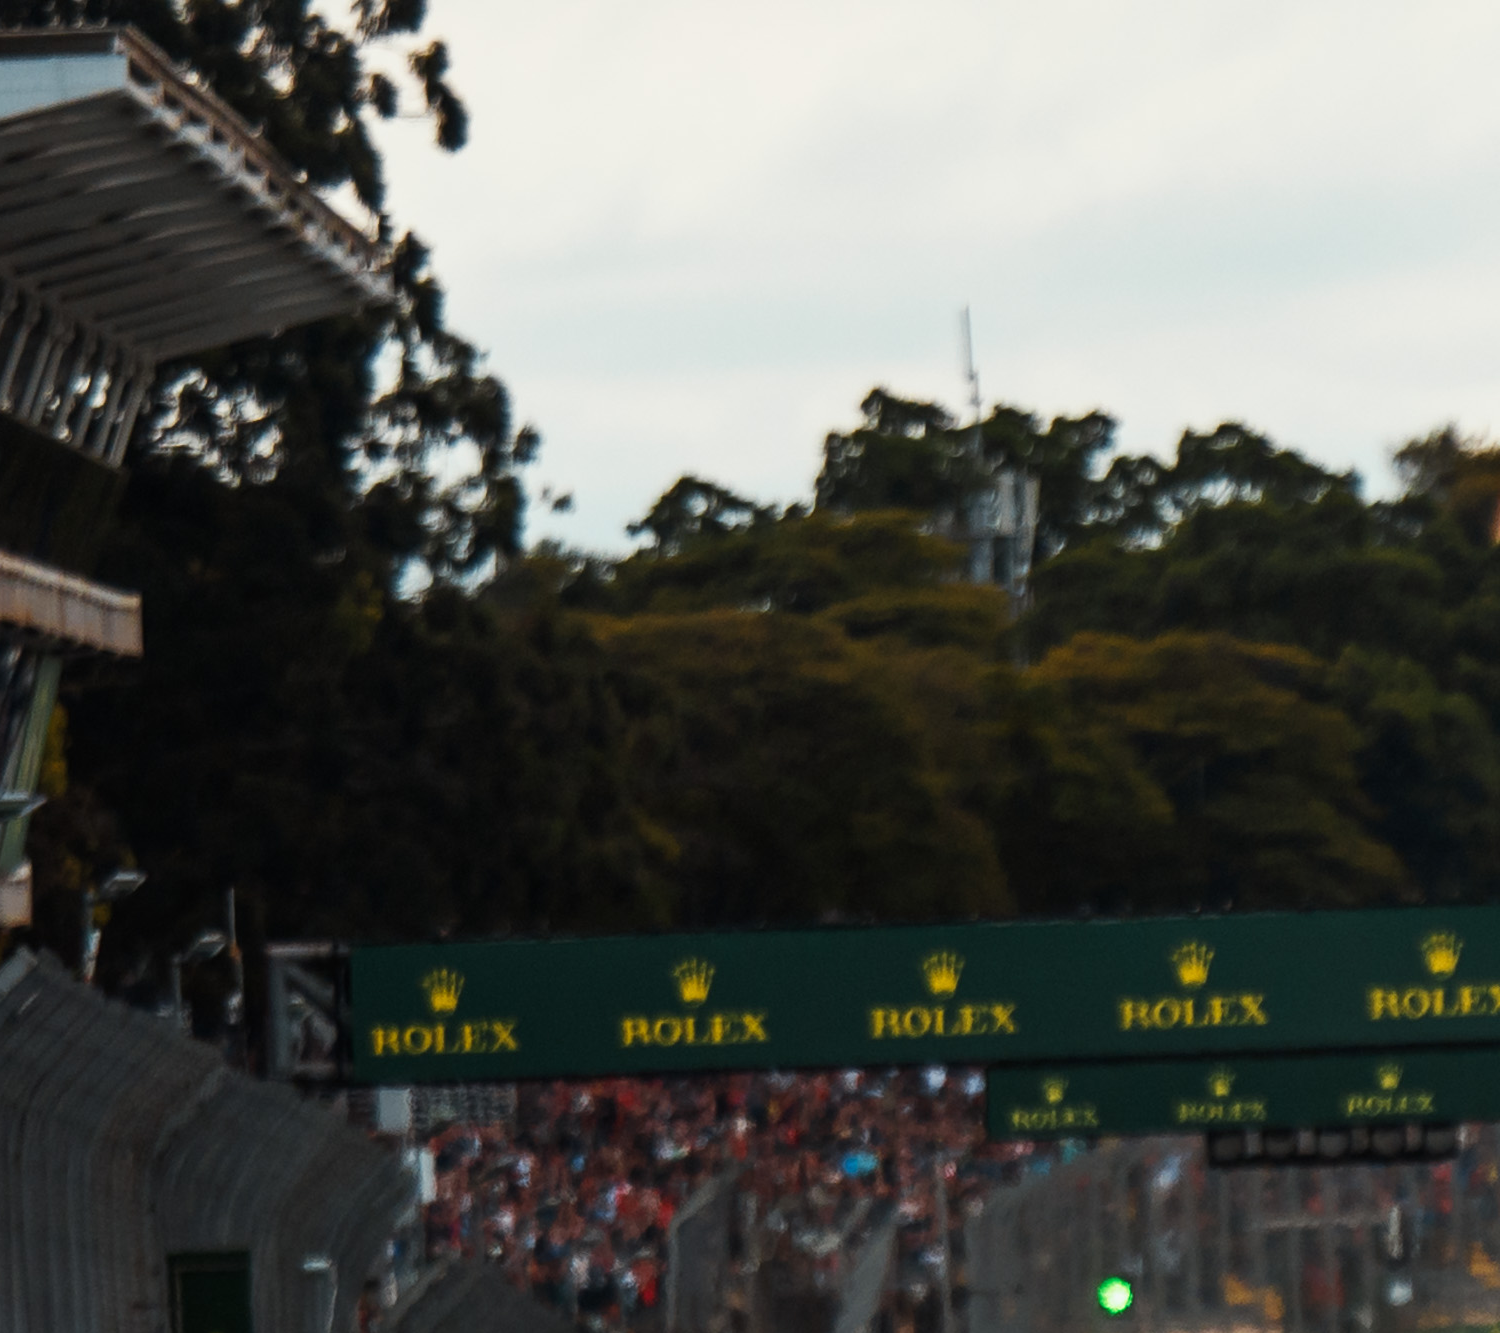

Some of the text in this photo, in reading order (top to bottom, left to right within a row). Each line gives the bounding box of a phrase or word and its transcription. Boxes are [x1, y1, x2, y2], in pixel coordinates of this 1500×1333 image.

[871, 1004, 1016, 1039] ROLEX
[1120, 994, 1267, 1031] ROLEX
[372, 1022, 518, 1057] ROLEX
[621, 1013, 767, 1048] ROLEX
